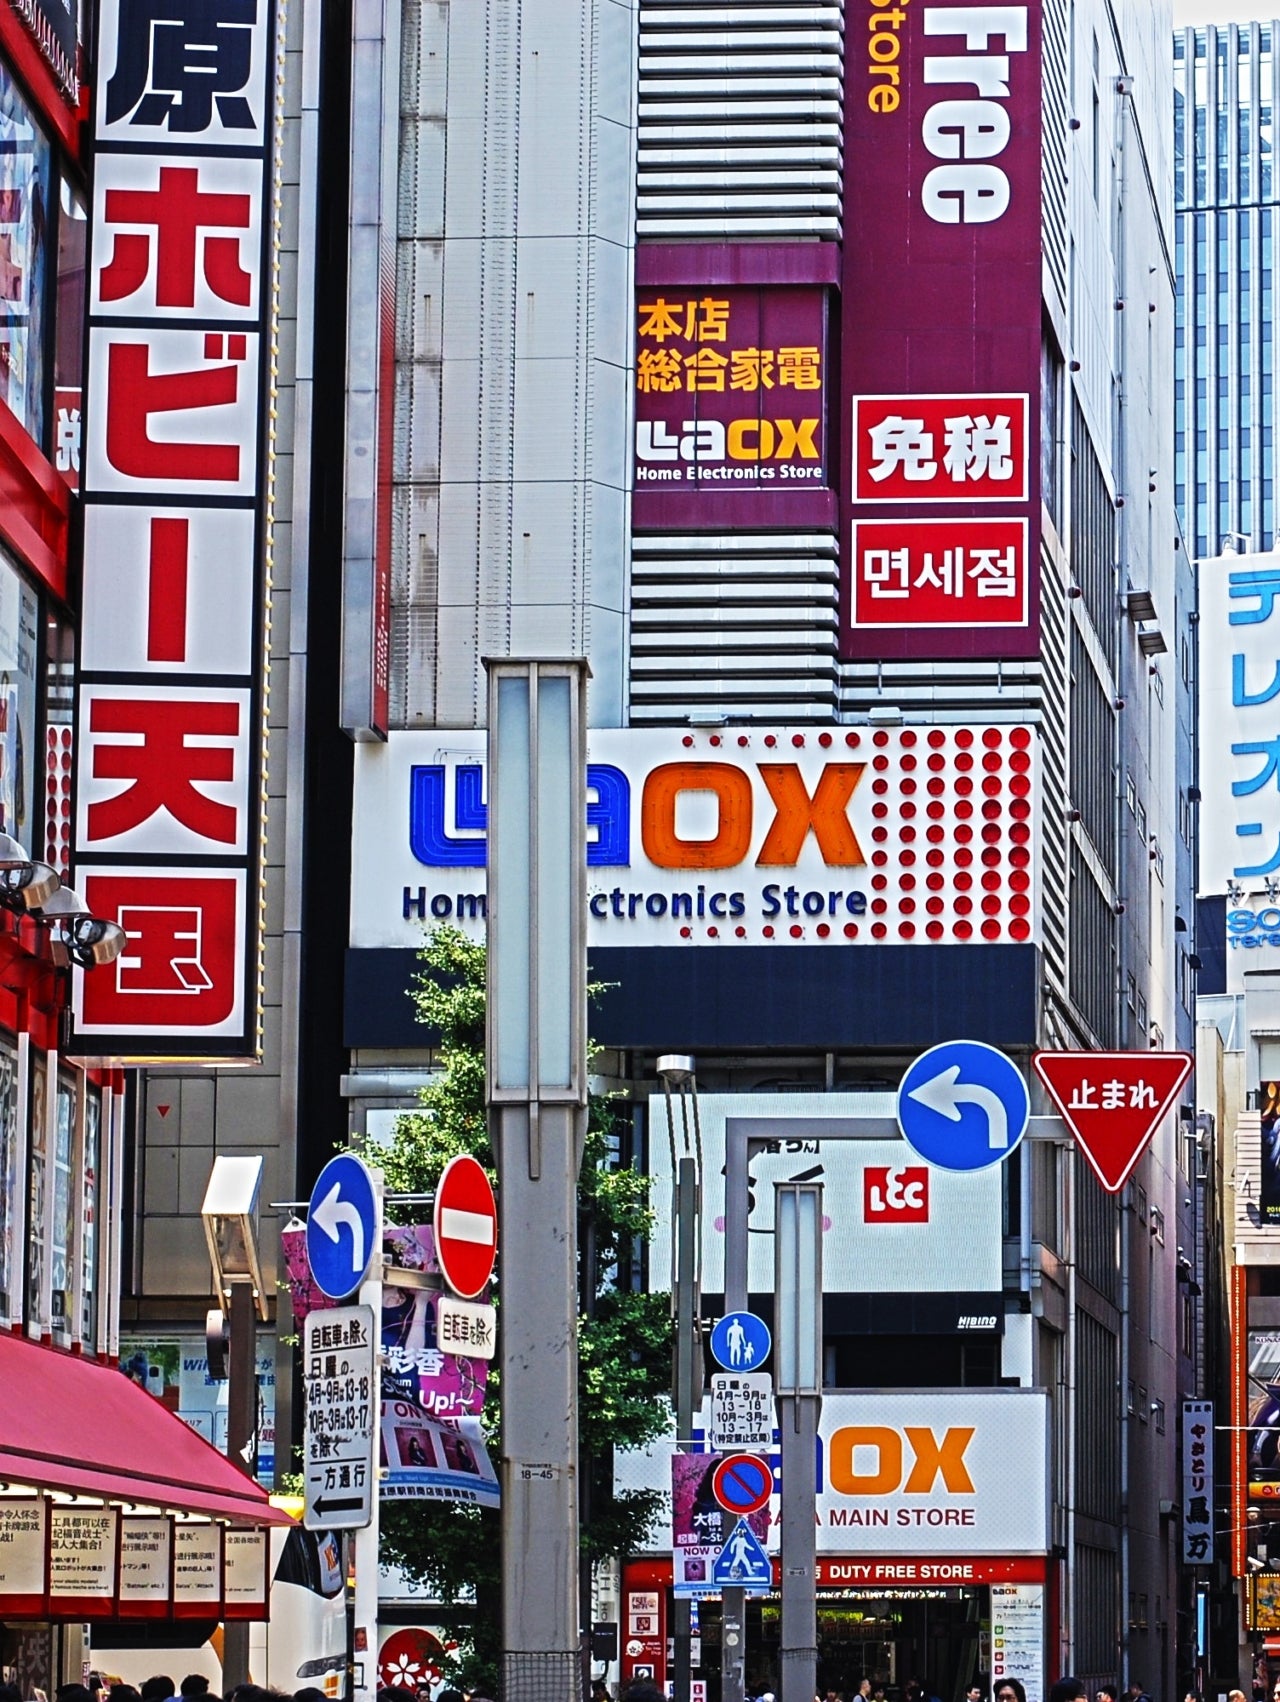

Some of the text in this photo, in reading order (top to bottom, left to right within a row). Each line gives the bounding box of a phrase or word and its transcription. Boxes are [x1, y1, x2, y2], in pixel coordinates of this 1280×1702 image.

[922, 7, 1028, 224] Free
[638, 298, 729, 343] 本店
[636, 347, 822, 393] 総合家電
[867, 414, 1014, 484] 免税
[637, 464, 823, 481] Home Electronics Store
[863, 547, 1017, 599] 면세점
[402, 885, 488, 919] Hom
[762, 883, 867, 918] Store
[1067, 1078, 1160, 1110] 止まれ
[310, 1465, 366, 1490] 一方通行
[521, 1469, 553, 1479] 18-45
[829, 1510, 888, 1527] MAIN
[896, 1509, 975, 1527] STORE
[829, 1565, 973, 1578] DUTY FREE STORE
